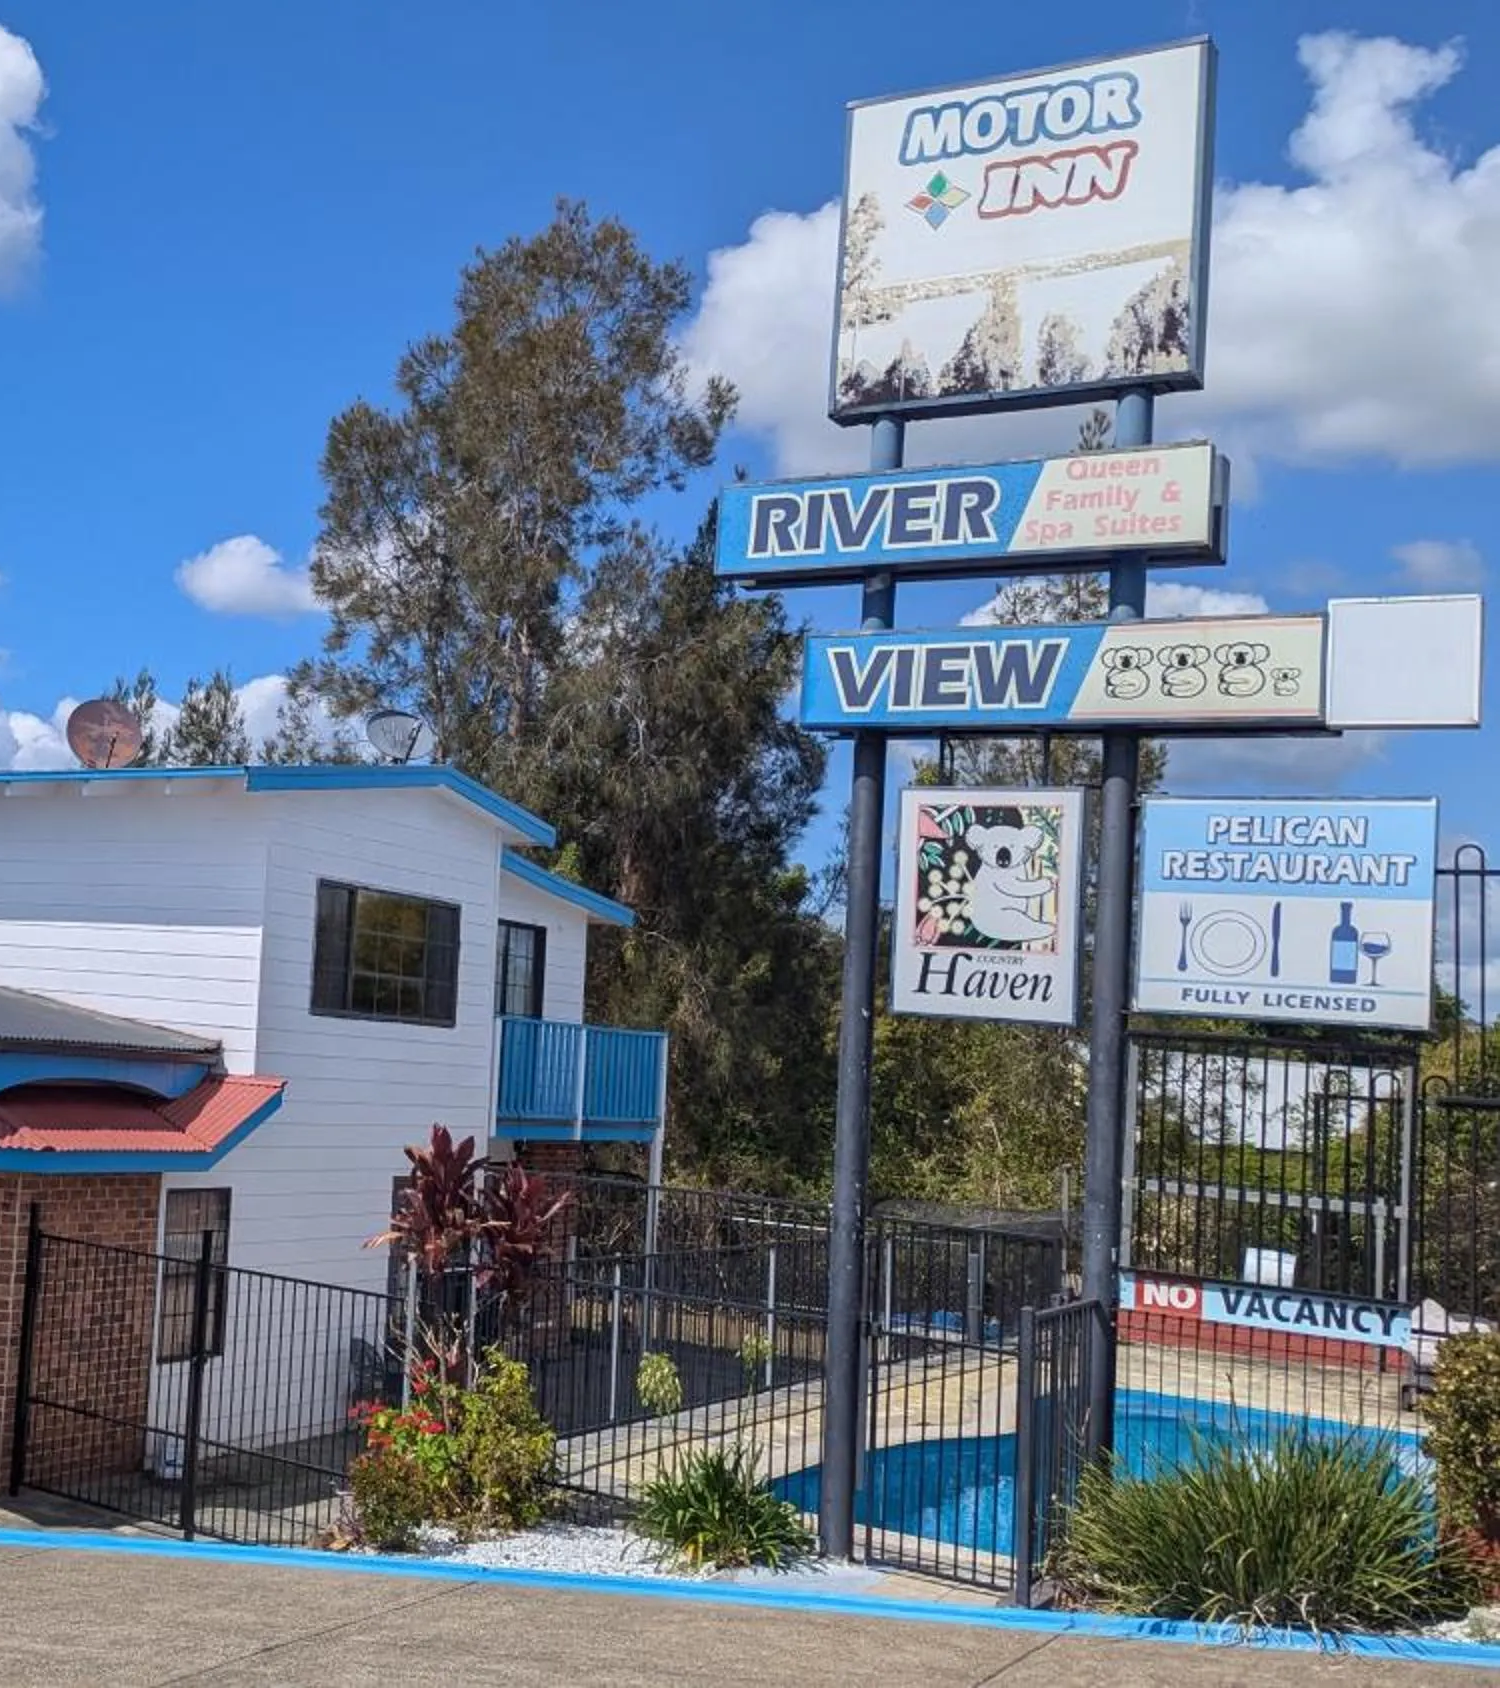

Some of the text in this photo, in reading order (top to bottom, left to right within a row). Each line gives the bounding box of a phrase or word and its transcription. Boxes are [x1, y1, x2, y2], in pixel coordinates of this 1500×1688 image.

[899, 71, 1141, 166] MOTOR
[978, 139, 1139, 219] INN
[1066, 457, 1161, 481] Queen
[747, 475, 1001, 560] RIVER
[1045, 480, 1182, 512] Family &
[1024, 513, 1183, 545] Spa Suites
[827, 637, 1071, 713] VIEW
[1206, 814, 1369, 847] PELICAN
[1161, 850, 1416, 887] RESTAURANT
[911, 951, 1053, 1003] Haven
[1180, 987, 1377, 1013] FULLY LICENSED
[1142, 1283, 1401, 1337] NO VACANCY
